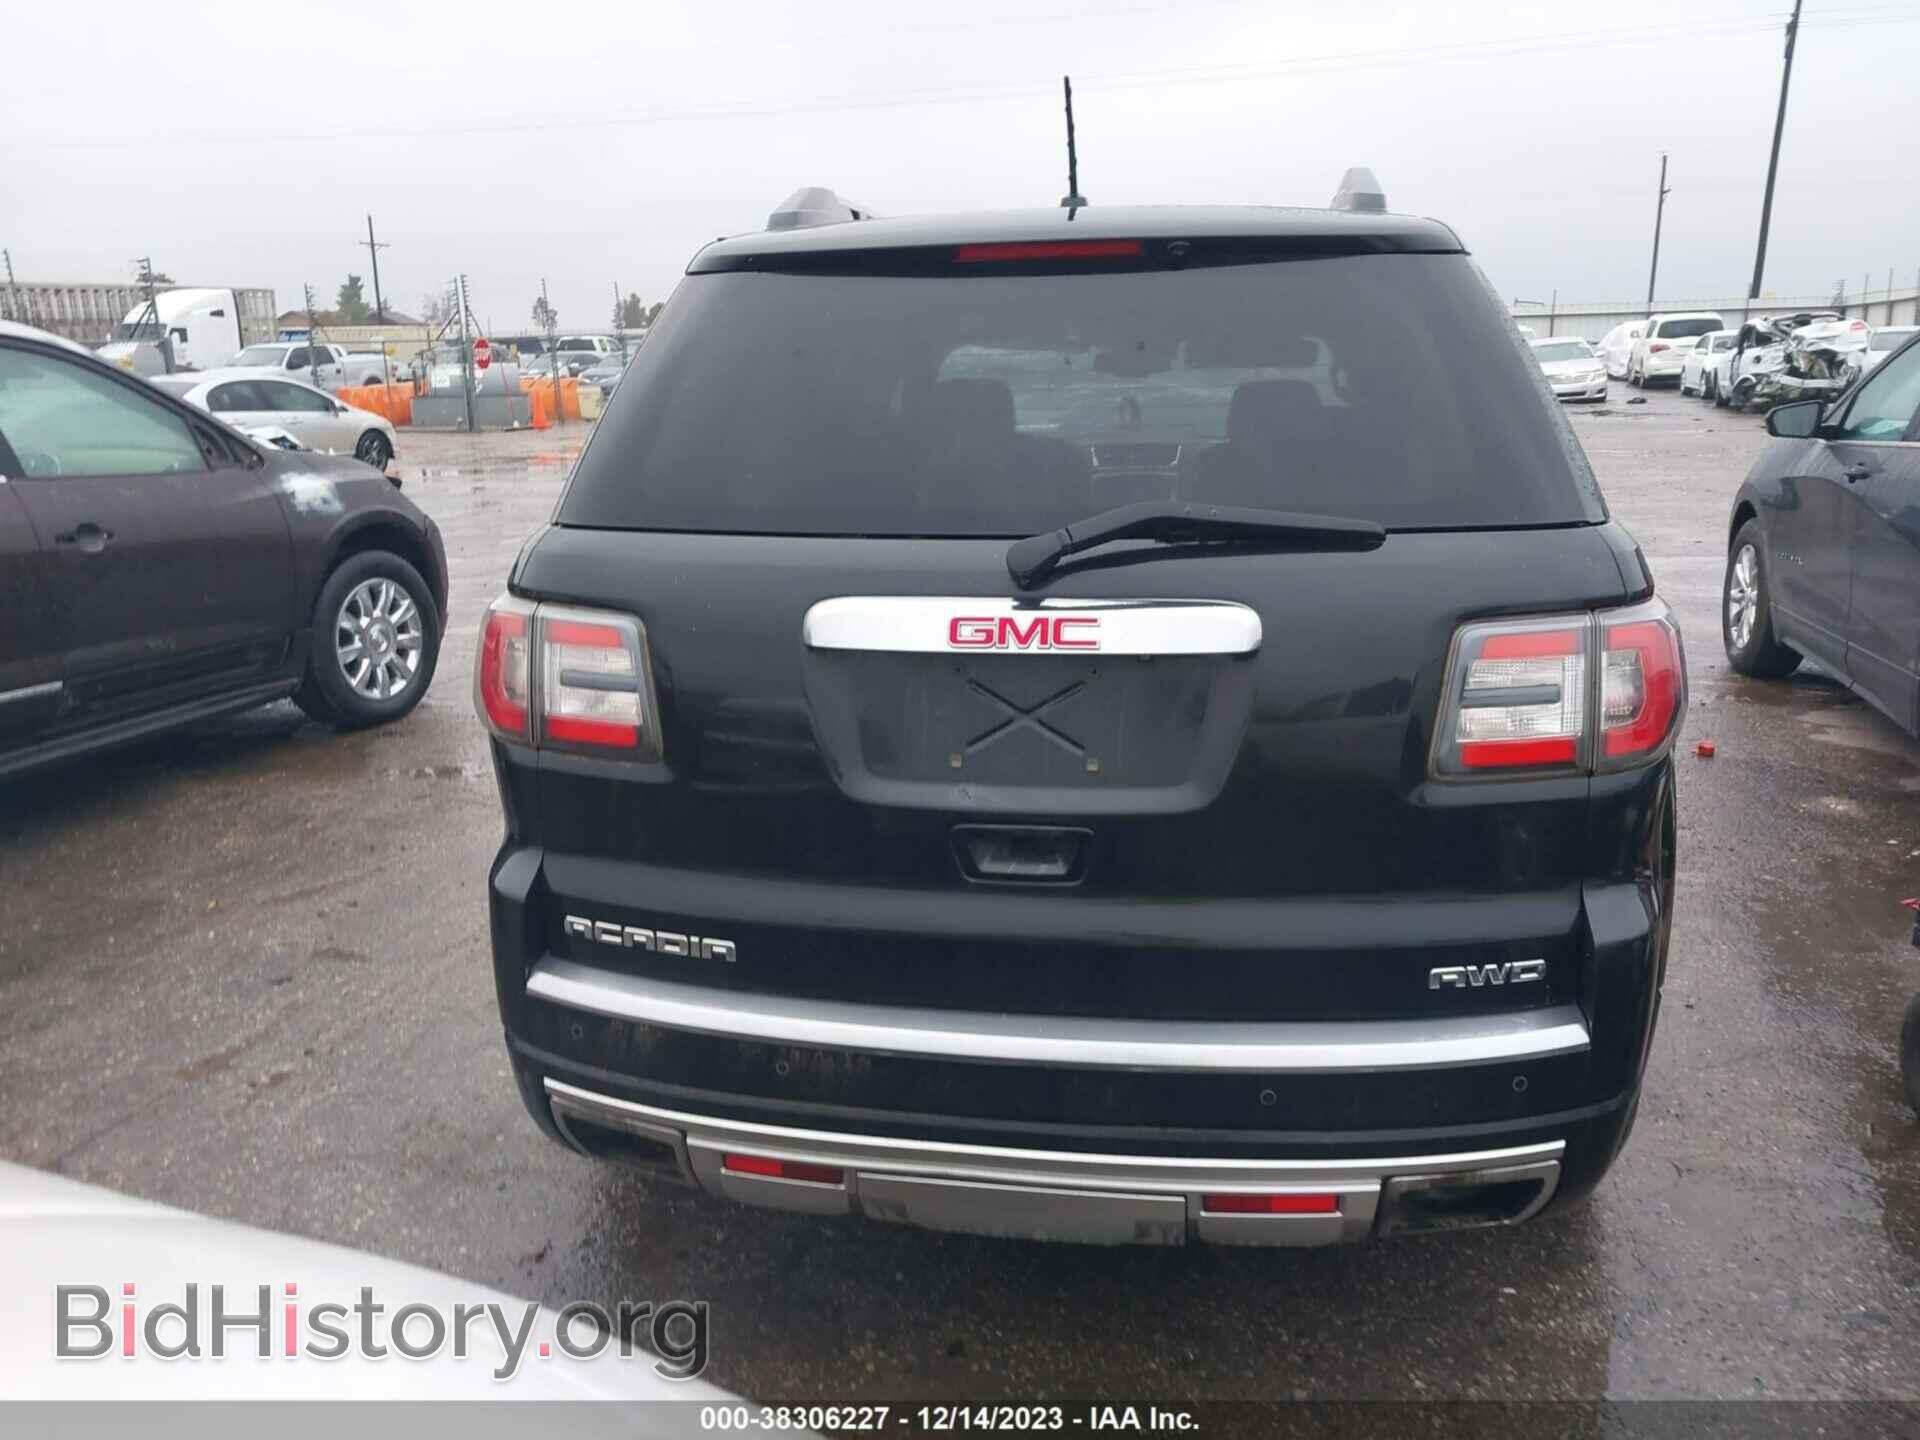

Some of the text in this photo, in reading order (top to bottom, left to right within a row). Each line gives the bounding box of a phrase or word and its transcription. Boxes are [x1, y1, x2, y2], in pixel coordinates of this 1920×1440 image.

[948, 615, 1101, 650] GMC
[563, 914, 737, 962] ACADIA
[1428, 958, 1546, 989] AWD
